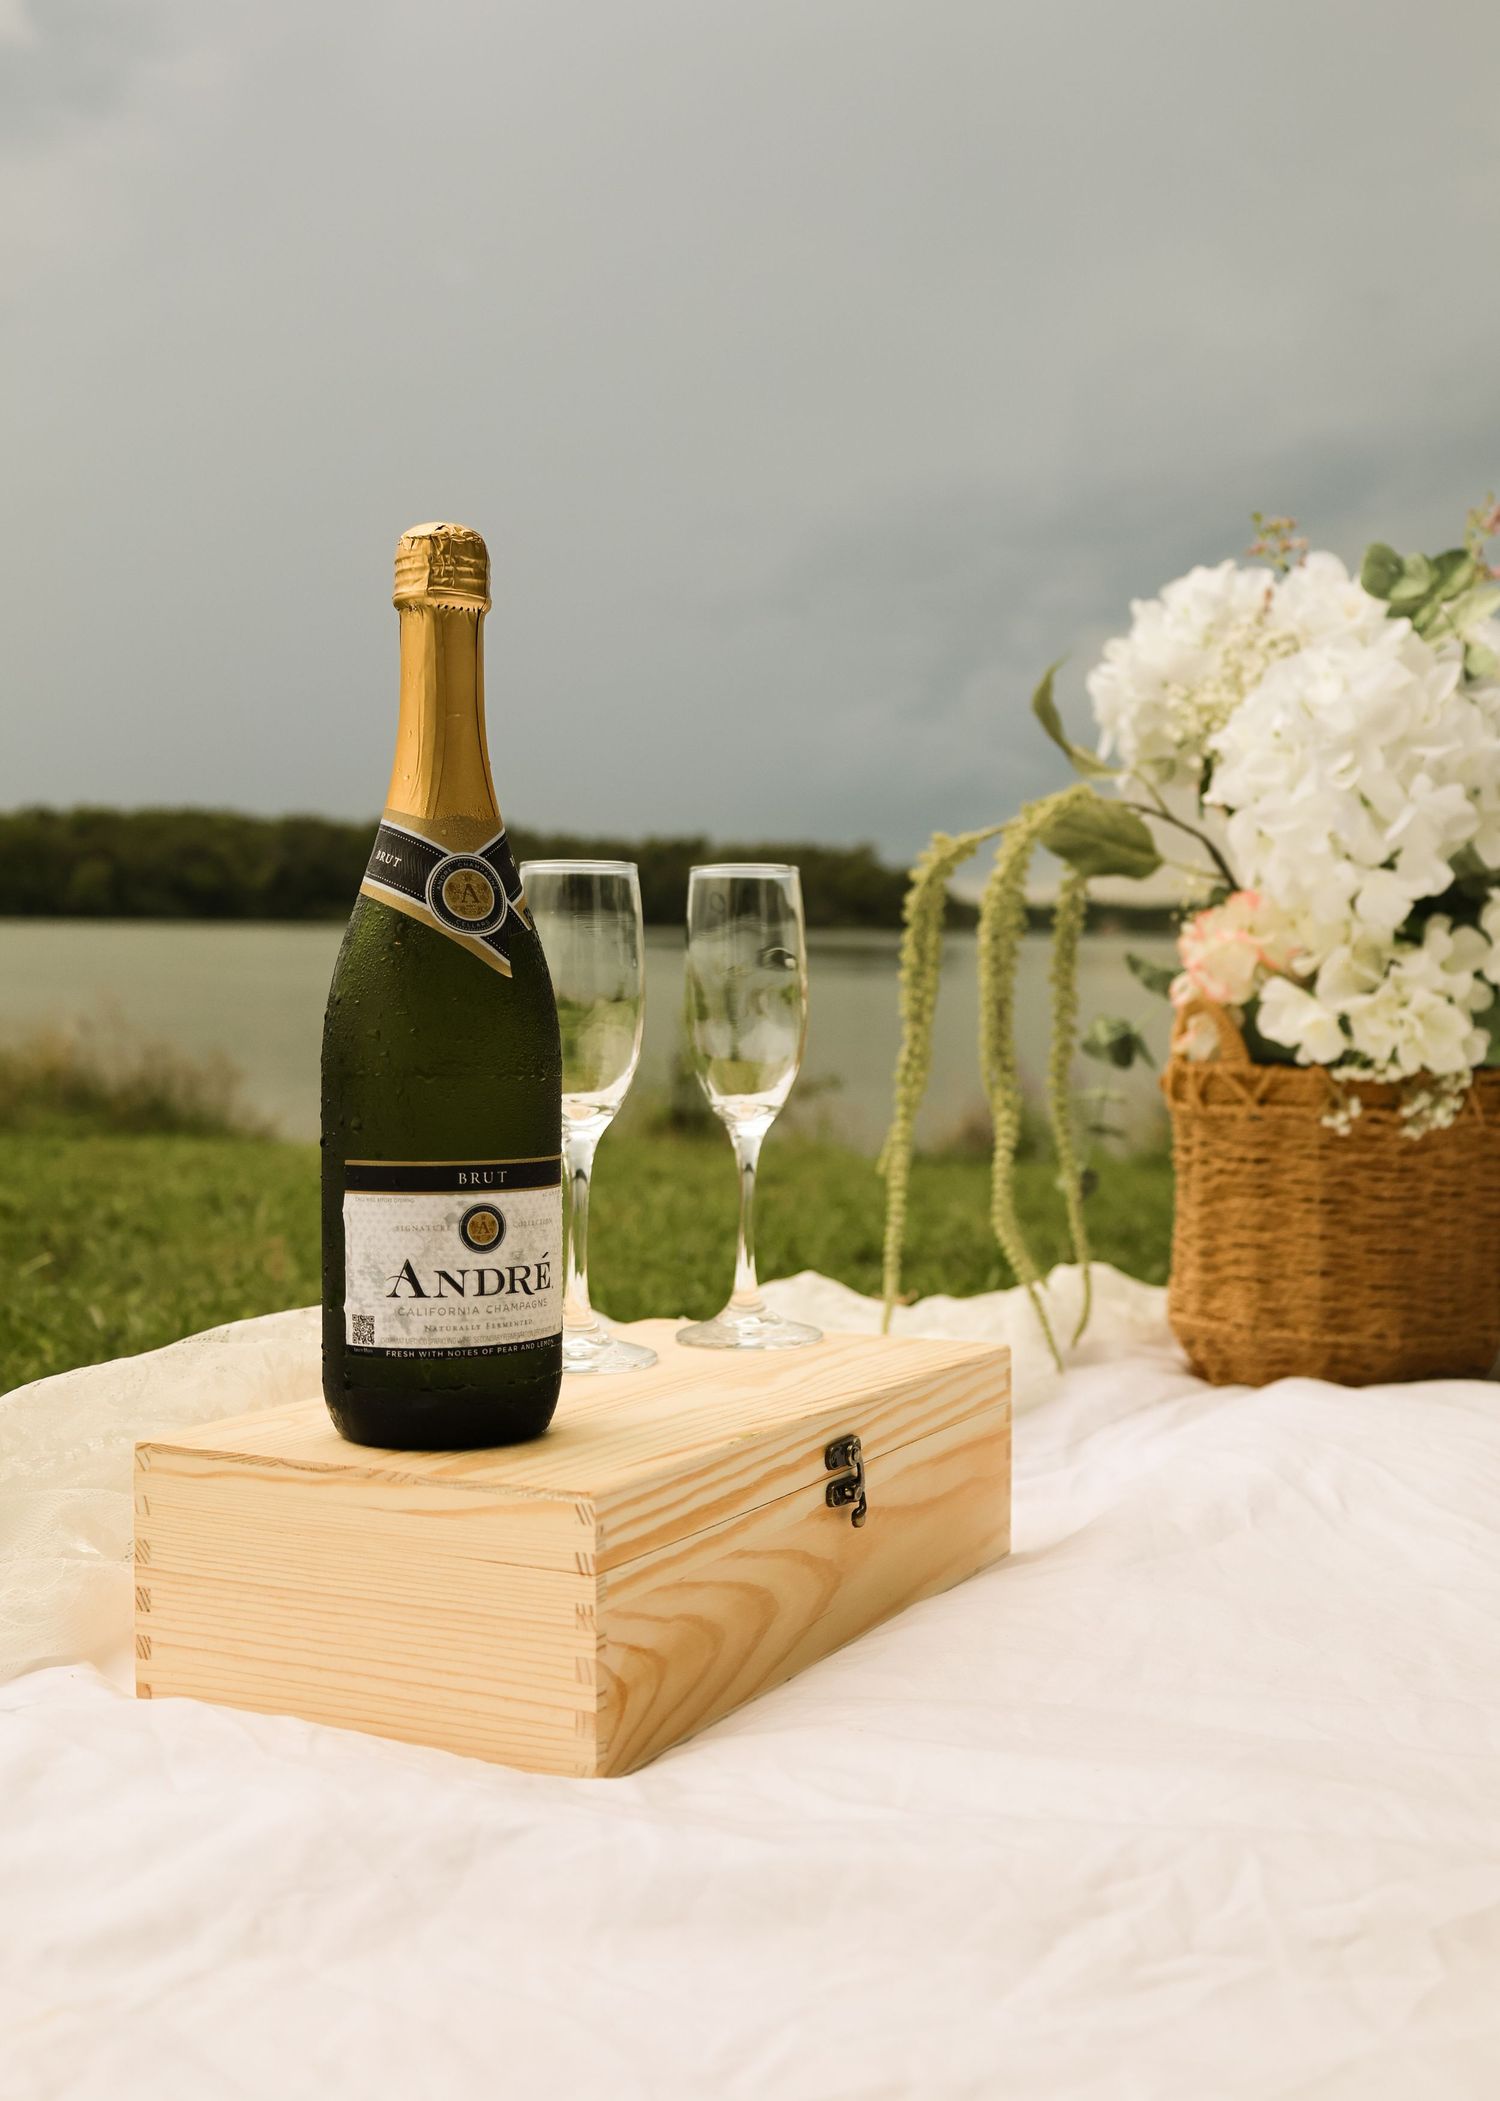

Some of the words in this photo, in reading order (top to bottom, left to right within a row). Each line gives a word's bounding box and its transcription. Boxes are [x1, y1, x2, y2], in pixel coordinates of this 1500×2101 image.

[375, 849, 402, 868] BRUT
[458, 1170, 508, 1185] BRUT
[385, 1251, 552, 1299] ANDRÉ
[397, 1305, 479, 1317] CALIFORNIA
[486, 1297, 548, 1315] CHAMPAGNE
[423, 1322, 481, 1333] NATURALLY
[385, 1350, 415, 1358] FRESH
[418, 1349, 444, 1358] WITH
[447, 1348, 479, 1358] NOTES
[481, 1347, 494, 1356] OF
[496, 1345, 518, 1355] PEAR
[520, 1342, 535, 1351] AND
